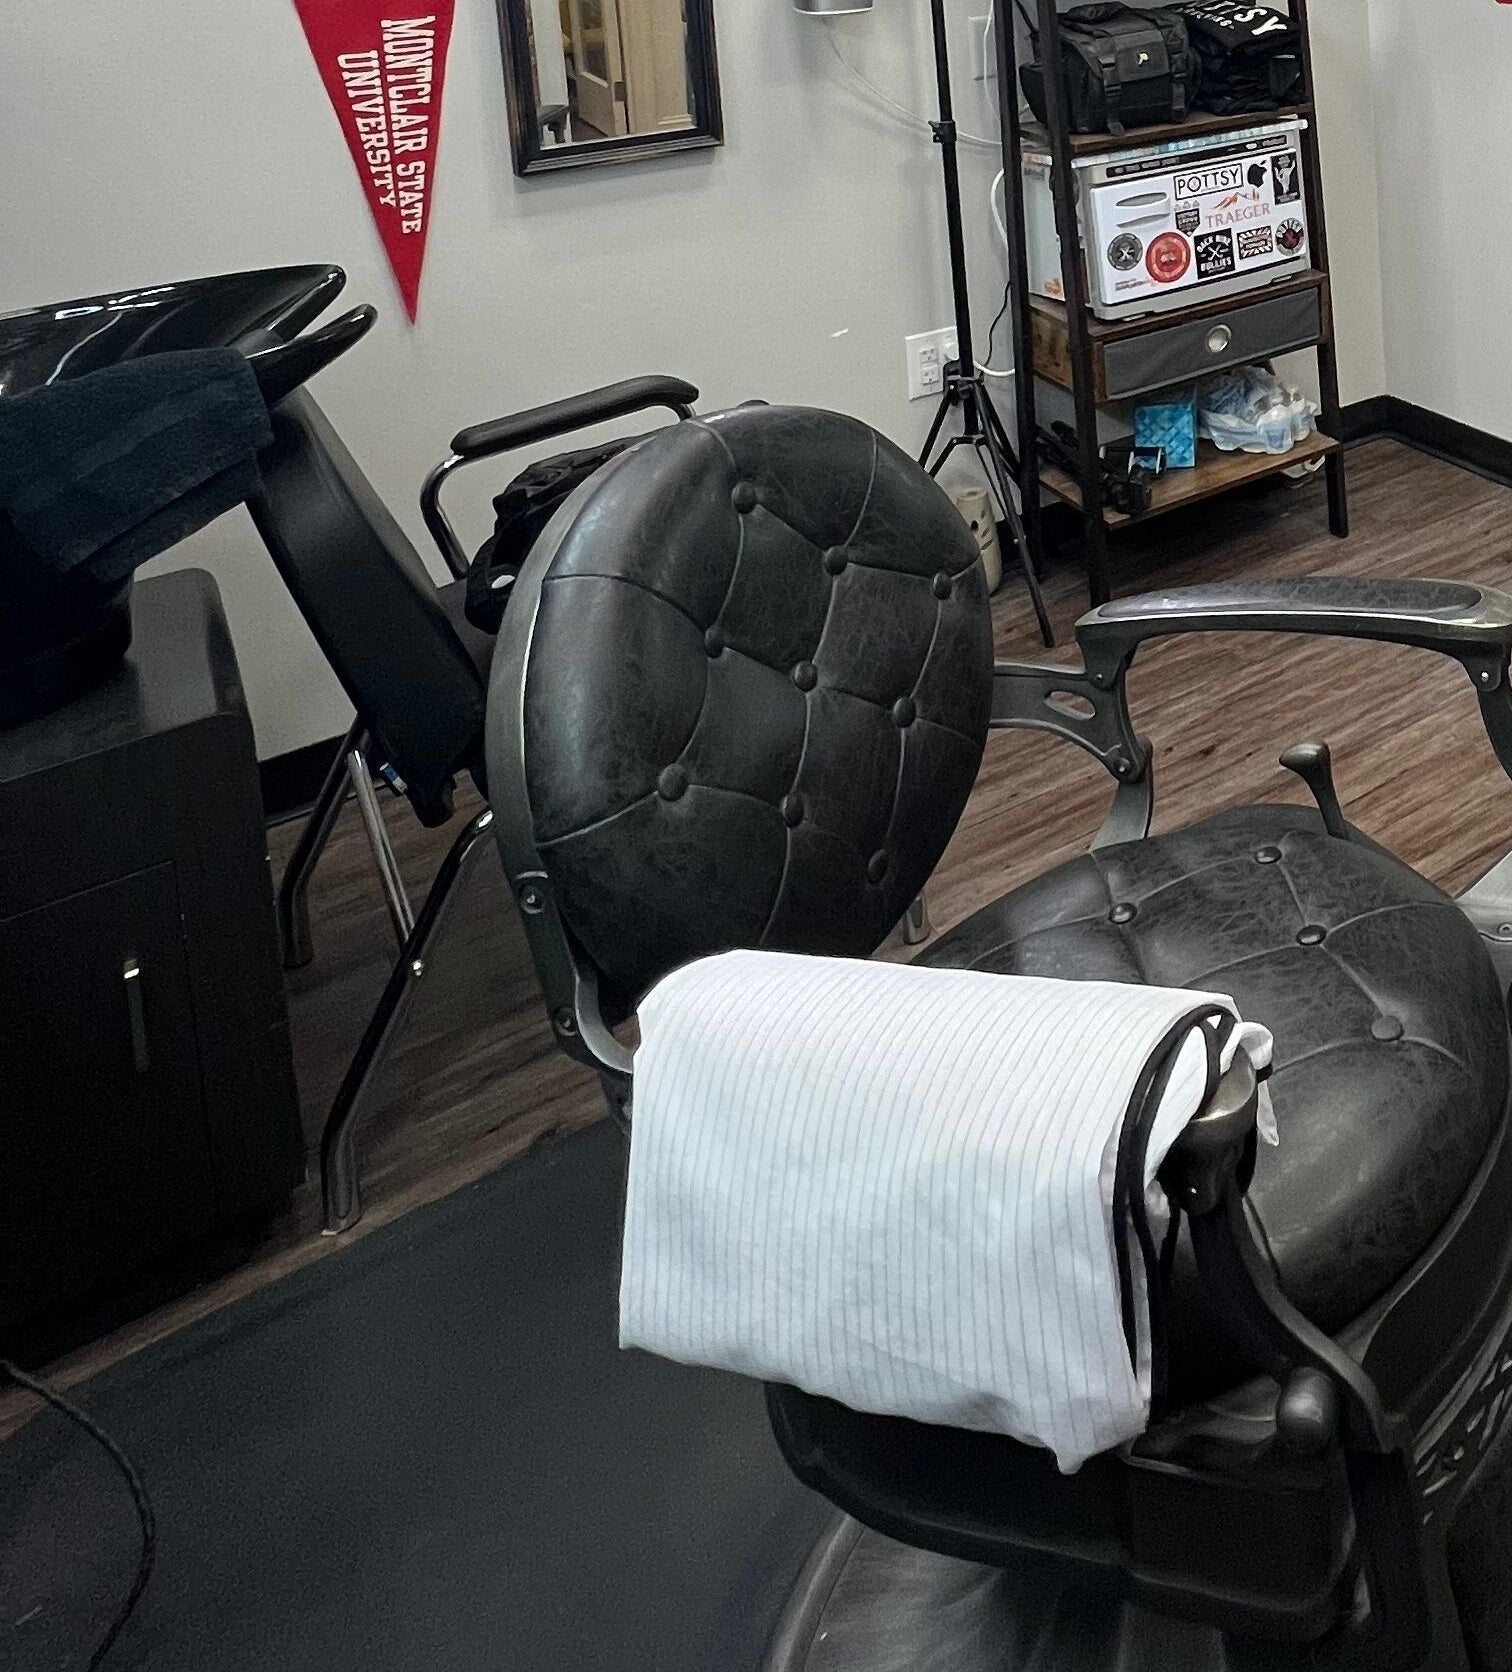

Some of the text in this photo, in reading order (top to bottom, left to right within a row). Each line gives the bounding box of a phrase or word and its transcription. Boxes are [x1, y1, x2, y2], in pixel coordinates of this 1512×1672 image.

[337, 49, 397, 207] UNIVERSITY
[380, 15, 436, 234] MONTCLAIR STATE
[1177, 167, 1240, 196] POTTSY
[1205, 203, 1271, 229] TRAEGER
